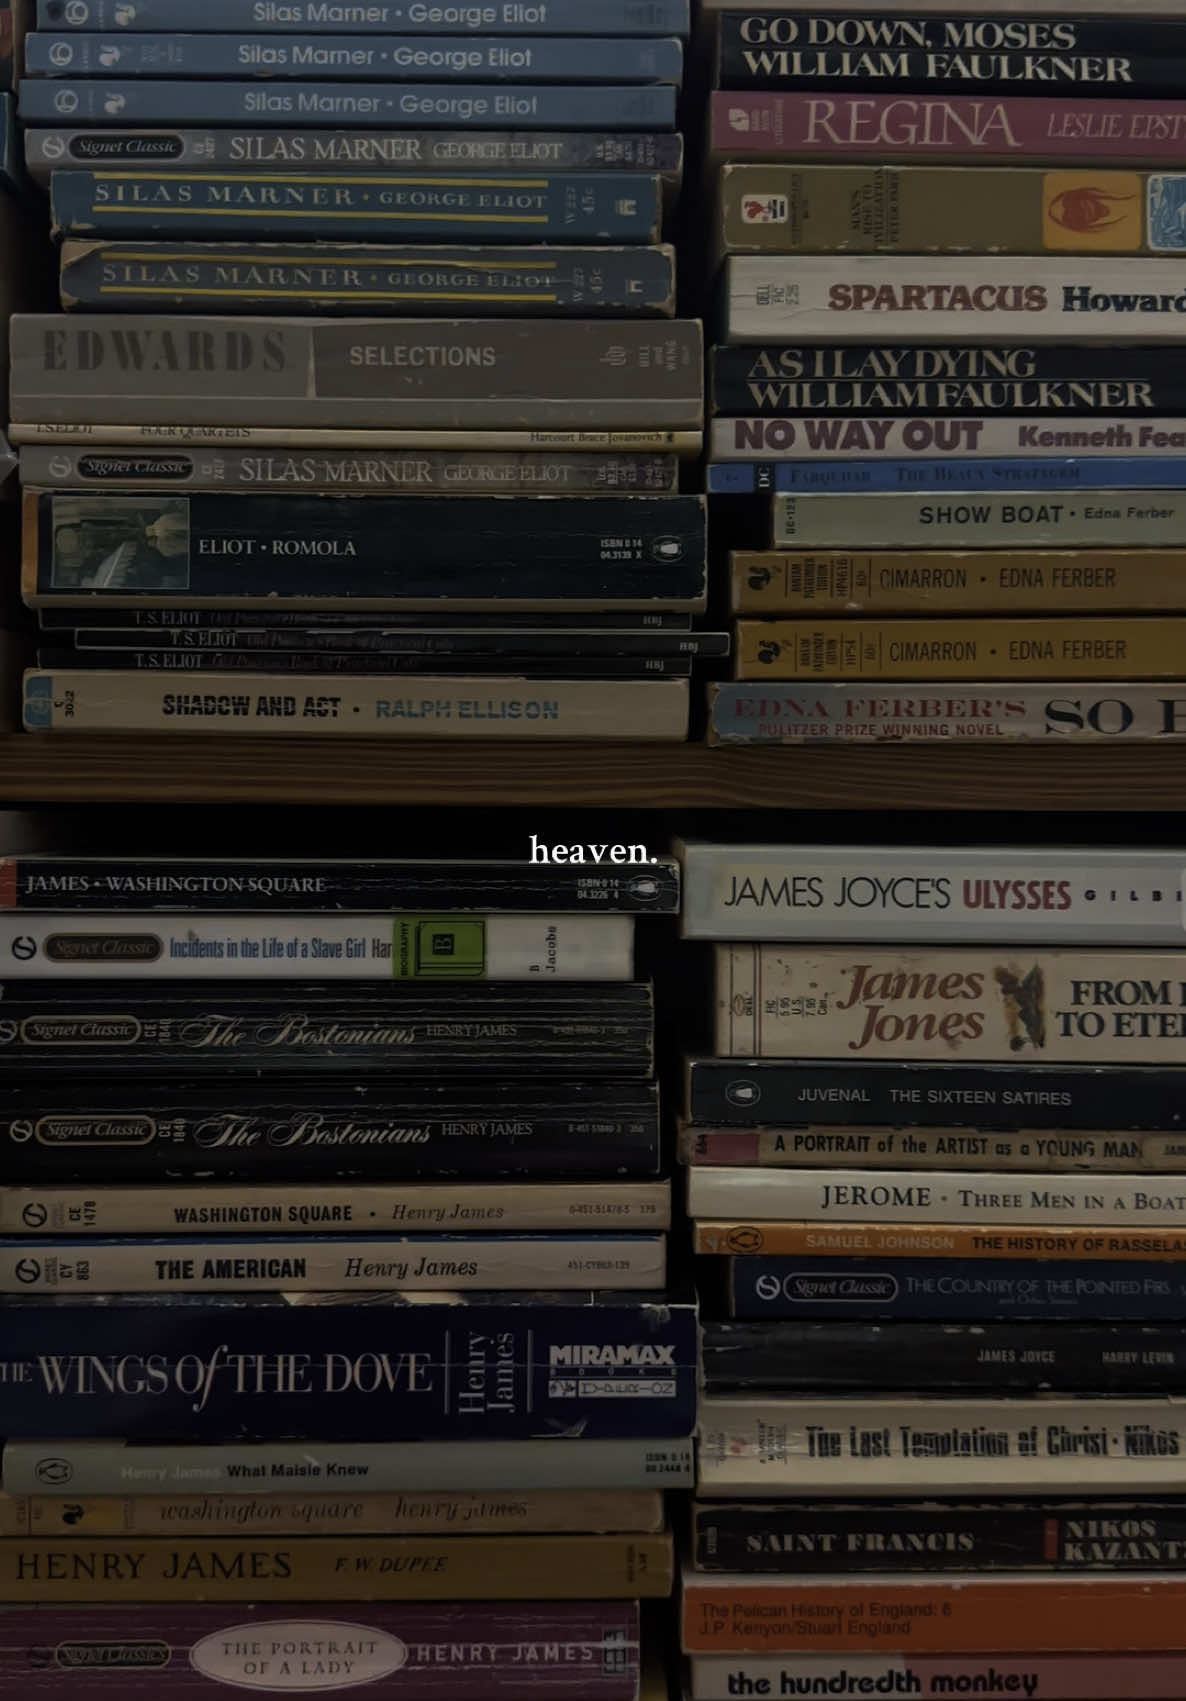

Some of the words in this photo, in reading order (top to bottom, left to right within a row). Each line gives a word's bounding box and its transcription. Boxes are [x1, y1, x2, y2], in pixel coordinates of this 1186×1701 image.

[739, 17, 799, 45] GO
[808, 18, 932, 48] DOWN,
[944, 21, 1077, 50] MOSES
[238, 45, 288, 65] Silas
[292, 46, 374, 66] Marner
[393, 47, 481, 70] George
[488, 47, 532, 67] Eliot
[742, 51, 910, 78] WILLIAM
[926, 54, 1135, 82] FAULKNER
[801, 99, 1024, 147] REGINA
[1047, 112, 1123, 138] LESLIE
[78, 139, 124, 156] Signet
[126, 139, 178, 154] Classic
[229, 137, 305, 160] SILAS
[313, 139, 421, 160] MARNER
[432, 142, 507, 159] GEORGE
[511, 142, 564, 159] ELIOT
[95, 184, 193, 201] SILAS
[208, 186, 353, 206] MARNER
[380, 191, 471, 206] GEORGE
[479, 194, 548, 209] ELIOT
[828, 284, 1048, 312] SPARTACUS
[43, 329, 286, 373] EDWARDS
[350, 346, 497, 367] SELECTIONS
[748, 350, 804, 378] AS
[813, 351, 824, 378] I
[833, 351, 905, 378] LAY
[915, 350, 1037, 378] DYING
[748, 382, 928, 409] WILLIAM
[937, 382, 1155, 408] FAULKNER
[735, 420, 796, 450] NO
[804, 420, 895, 450] WAY
[902, 421, 983, 451] OUT
[1019, 425, 1132, 448] Kenneth
[920, 507, 991, 524] SHOW
[1002, 506, 1063, 523] BOAT
[1085, 508, 1121, 519] Edna
[1127, 507, 1174, 519] Ferber
[199, 539, 256, 555] ELIOT
[272, 540, 356, 556] ROMOLA
[880, 569, 967, 589] CIMARRON
[1000, 568, 1043, 588] EDNA
[1052, 568, 1117, 588] FERBER
[163, 694, 251, 718] SHADOW
[257, 697, 296, 717] AND
[303, 697, 341, 718] ACT
[376, 700, 451, 719] RALPH
[459, 701, 559, 720] ELLISON
[736, 700, 829, 718] EDNA
[845, 700, 1025, 719] FERBER'S
[1045, 699, 1134, 735] SO
[760, 724, 829, 736] PULITZER
[835, 724, 877, 736] PRIZE
[883, 724, 949, 737] WINNING
[957, 724, 1002, 736] NOVEL
[25, 876, 89, 894] JAMES
[105, 876, 243, 893] WASHINGTON
[248, 877, 327, 896] SQUARE
[725, 876, 823, 907] JAMES
[833, 877, 951, 909] JOYCE'S
[963, 879, 1072, 909] ULYSSES
[170, 937, 225, 958] Incidents
[241, 937, 260, 958] the
[262, 937, 284, 958] Life
[286, 937, 299, 958] of
[311, 937, 343, 958] Slave
[346, 938, 367, 958] Girl
[545, 926, 557, 973] Jacobs
[836, 965, 985, 1010] James
[1071, 980, 1173, 1006] FROM
[847, 1005, 985, 1050] Jones
[1056, 1012, 1105, 1037] TO
[798, 1088, 871, 1102] JUVENAL
[889, 1089, 921, 1103] THE
[928, 1090, 997, 1105] SIXTEEN
[1002, 1091, 1072, 1106] SATIRES
[192, 1113, 266, 1148] The
[267, 1112, 433, 1146] Bostonians
[775, 1135, 785, 1151] A
[795, 1136, 871, 1152] PORTRAIT
[878, 1136, 893, 1153] of
[903, 1136, 927, 1153] the
[936, 1138, 988, 1154] ARTIST
[1036, 1140, 1096, 1157] YOUNG
[1103, 1141, 1143, 1158] MAN
[822, 1186, 931, 1208] JEROME
[958, 1190, 1022, 1209] THREE
[1031, 1191, 1076, 1209] MEN
[1113, 1197, 1126, 1209] A
[175, 1207, 282, 1223] WASHINGTON
[288, 1206, 352, 1224] SQUARE
[392, 1205, 450, 1222] Henry
[451, 1204, 504, 1221] James
[806, 1234, 872, 1249] SAMUEL
[879, 1235, 954, 1250] JOHNSON
[973, 1237, 1003, 1249] THE
[1008, 1237, 1078, 1250] HISTORY
[1083, 1238, 1102, 1251] OF
[156, 1261, 194, 1280] THE
[202, 1259, 307, 1280] AMERICAN
[345, 1259, 409, 1280] Henry
[414, 1258, 479, 1278] James
[549, 1345, 678, 1366] MIRAMAX
[977, 1349, 1017, 1364] JAMES
[1020, 1350, 1057, 1364] JOYCE
[1102, 1351, 1139, 1365] HARRY
[1142, 1351, 1176, 1366] LEVIN
[38, 1354, 169, 1395] WINGS
[228, 1354, 313, 1395] THE
[325, 1353, 433, 1394] DOVE
[458, 1331, 486, 1414] Henry
[487, 1331, 515, 1414] James
[806, 1426, 841, 1458] The
[850, 1426, 890, 1458] Last
[900, 1426, 1009, 1457] Temptation
[1018, 1426, 1038, 1457] of
[1047, 1426, 1107, 1457] Christ
[1125, 1426, 1180, 1457] Nikos
[228, 1465, 265, 1477] What
[271, 1465, 320, 1477] Maisie
[327, 1465, 369, 1477] Knew
[1066, 1520, 1157, 1538] NIKOS
[747, 1533, 837, 1552] SAINT
[848, 1532, 976, 1552] FRANCIS
[16, 1552, 146, 1580] HENRY
[163, 1552, 292, 1579] JAMES
[702, 1603, 730, 1617] The
[733, 1603, 787, 1617] Pelican
[791, 1603, 844, 1621] History
[849, 1603, 864, 1617] of
[848, 1621, 911, 1637] England
[222, 1642, 263, 1656] THE
[271, 1641, 378, 1657] PORTRAIT
[416, 1646, 499, 1662] HENRY
[512, 1644, 593, 1661] JAMES
[244, 1662, 266, 1675] OF
[280, 1662, 291, 1675] A
[302, 1662, 354, 1675] LADY
[729, 1672, 771, 1694] the
[780, 1670, 921, 1694] hundredth
[931, 1668, 1039, 1697] monkey
